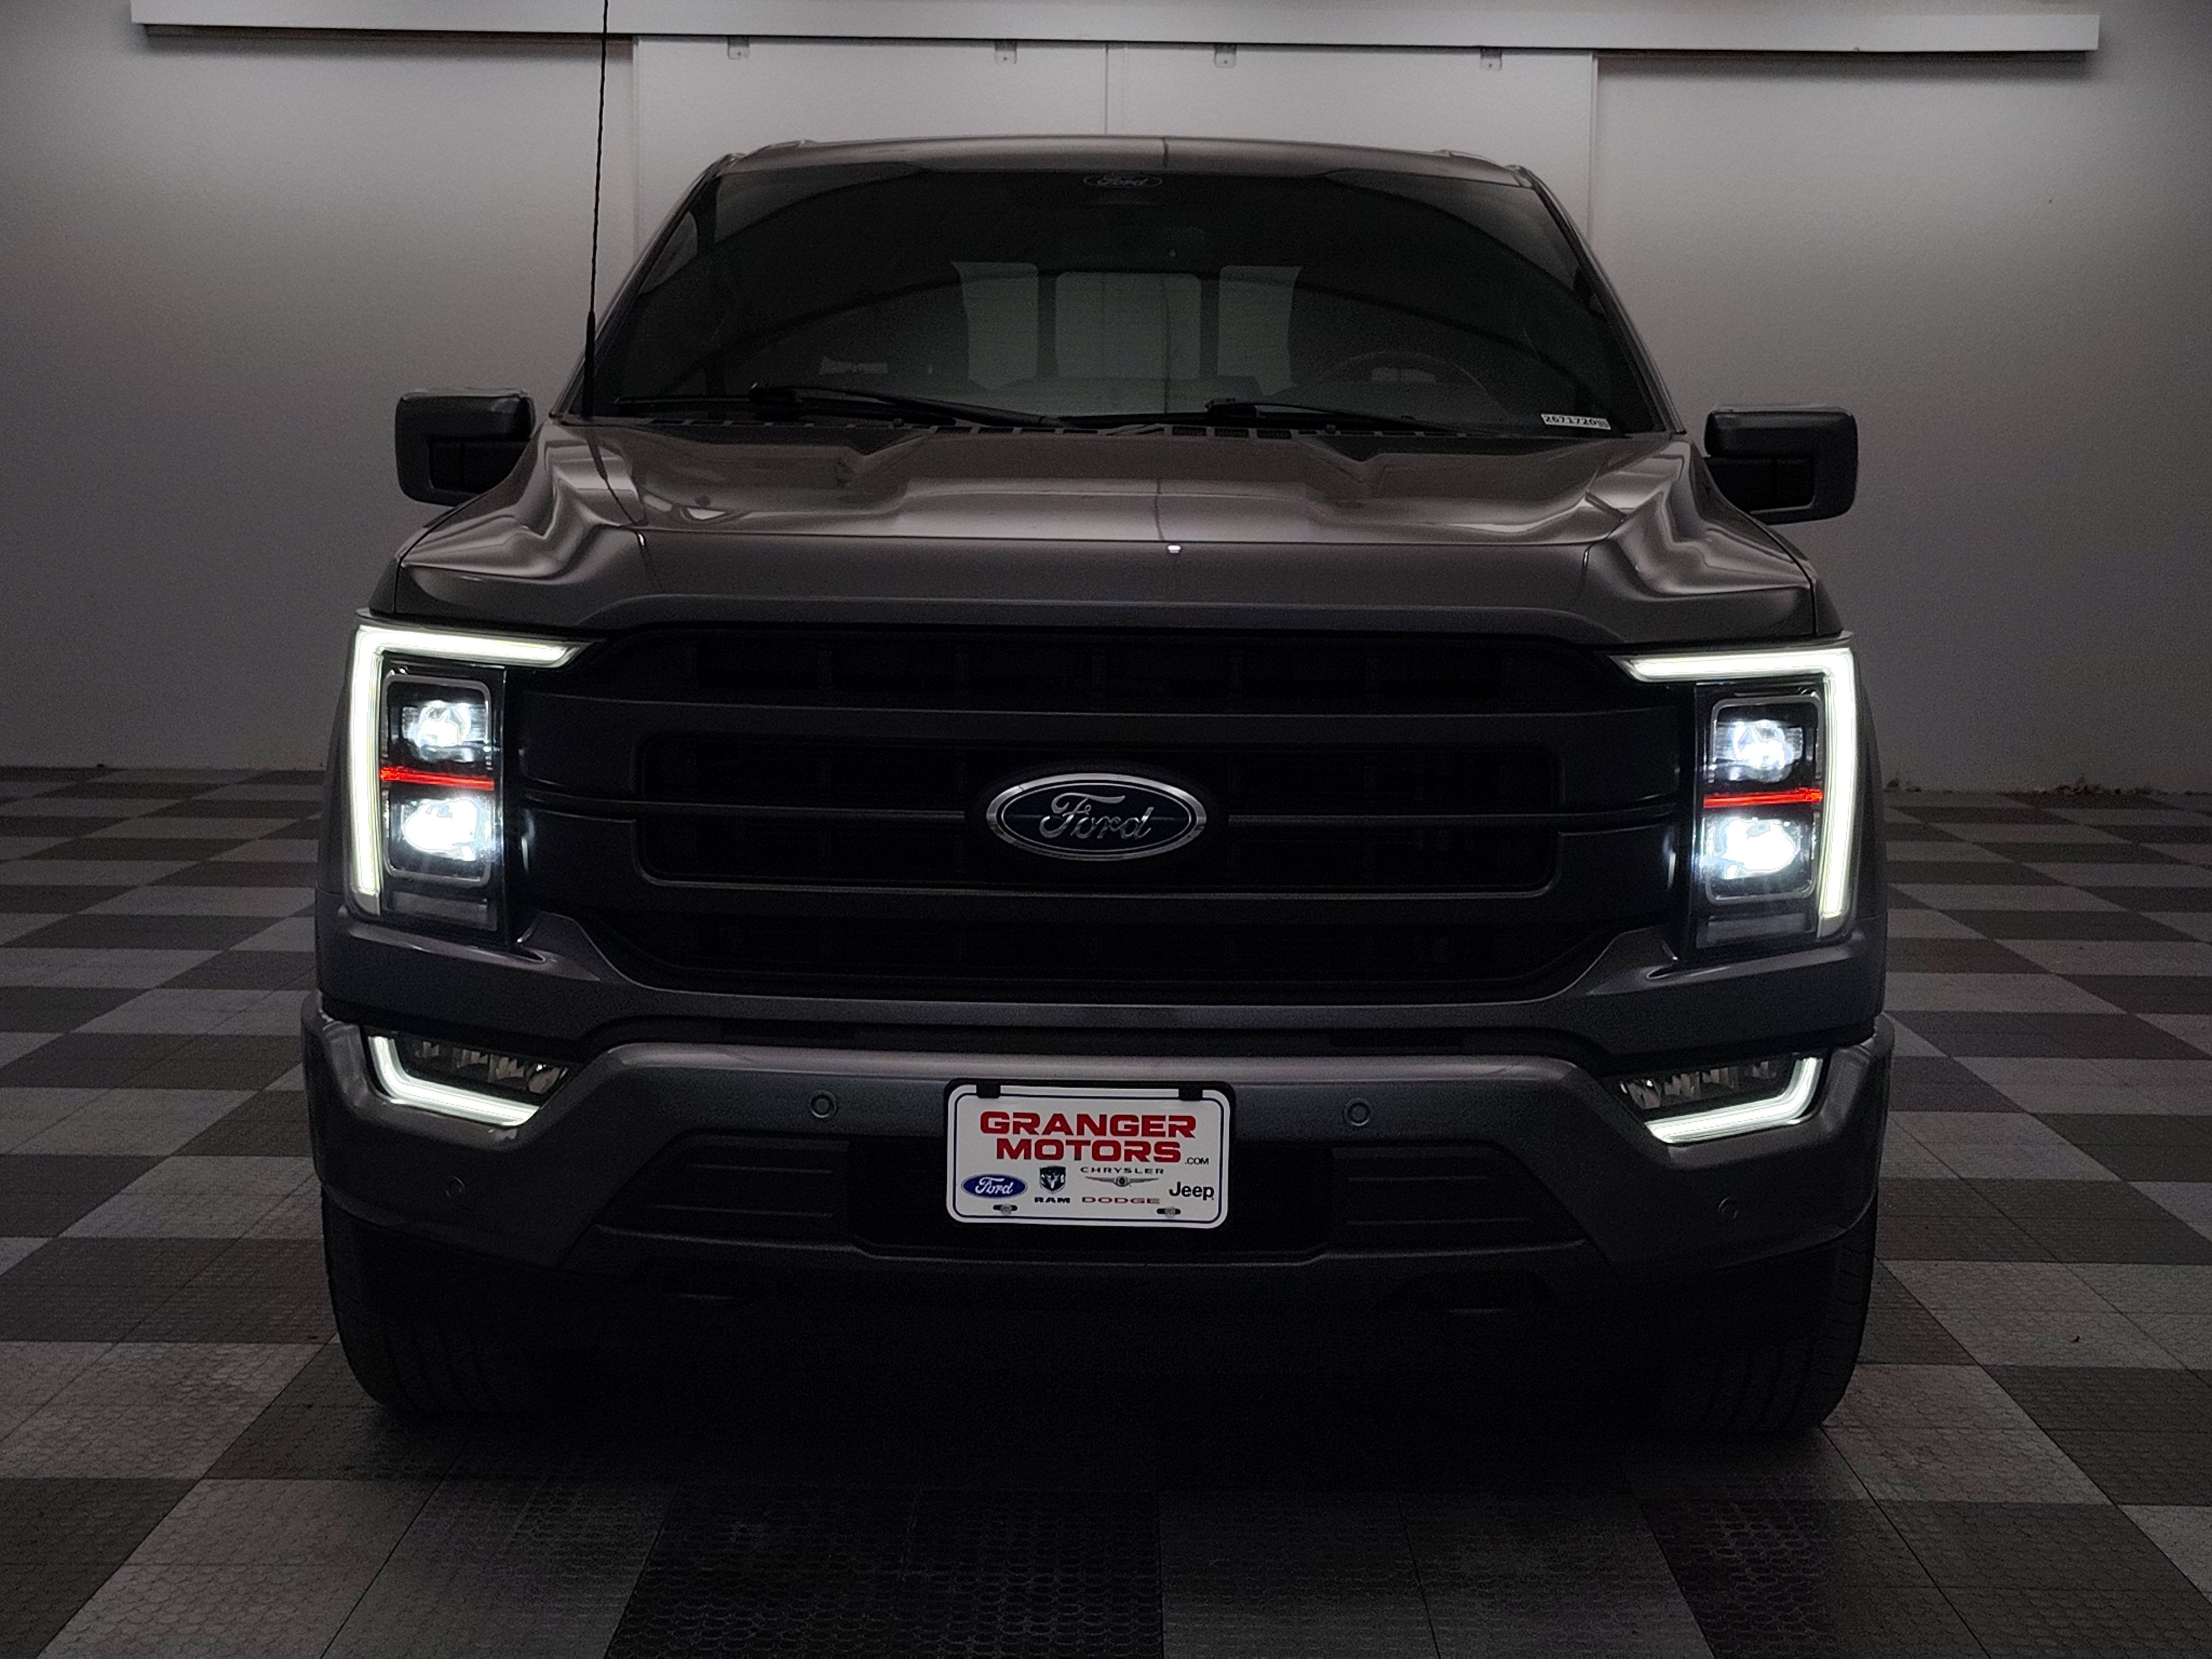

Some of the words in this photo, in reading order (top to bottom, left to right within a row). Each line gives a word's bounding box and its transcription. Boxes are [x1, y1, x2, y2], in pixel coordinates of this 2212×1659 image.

[1039, 792, 1154, 839] Ford
[980, 1111, 1196, 1138] GRANGER
[996, 1138, 1181, 1163] MOTORS
[1185, 1157, 1209, 1165] .COM
[1081, 1166, 1164, 1175] CHRYSLER
[975, 1177, 1014, 1195] Ford
[1169, 1182, 1214, 1200] Jeep
[1082, 1197, 1161, 1205] DODGE
